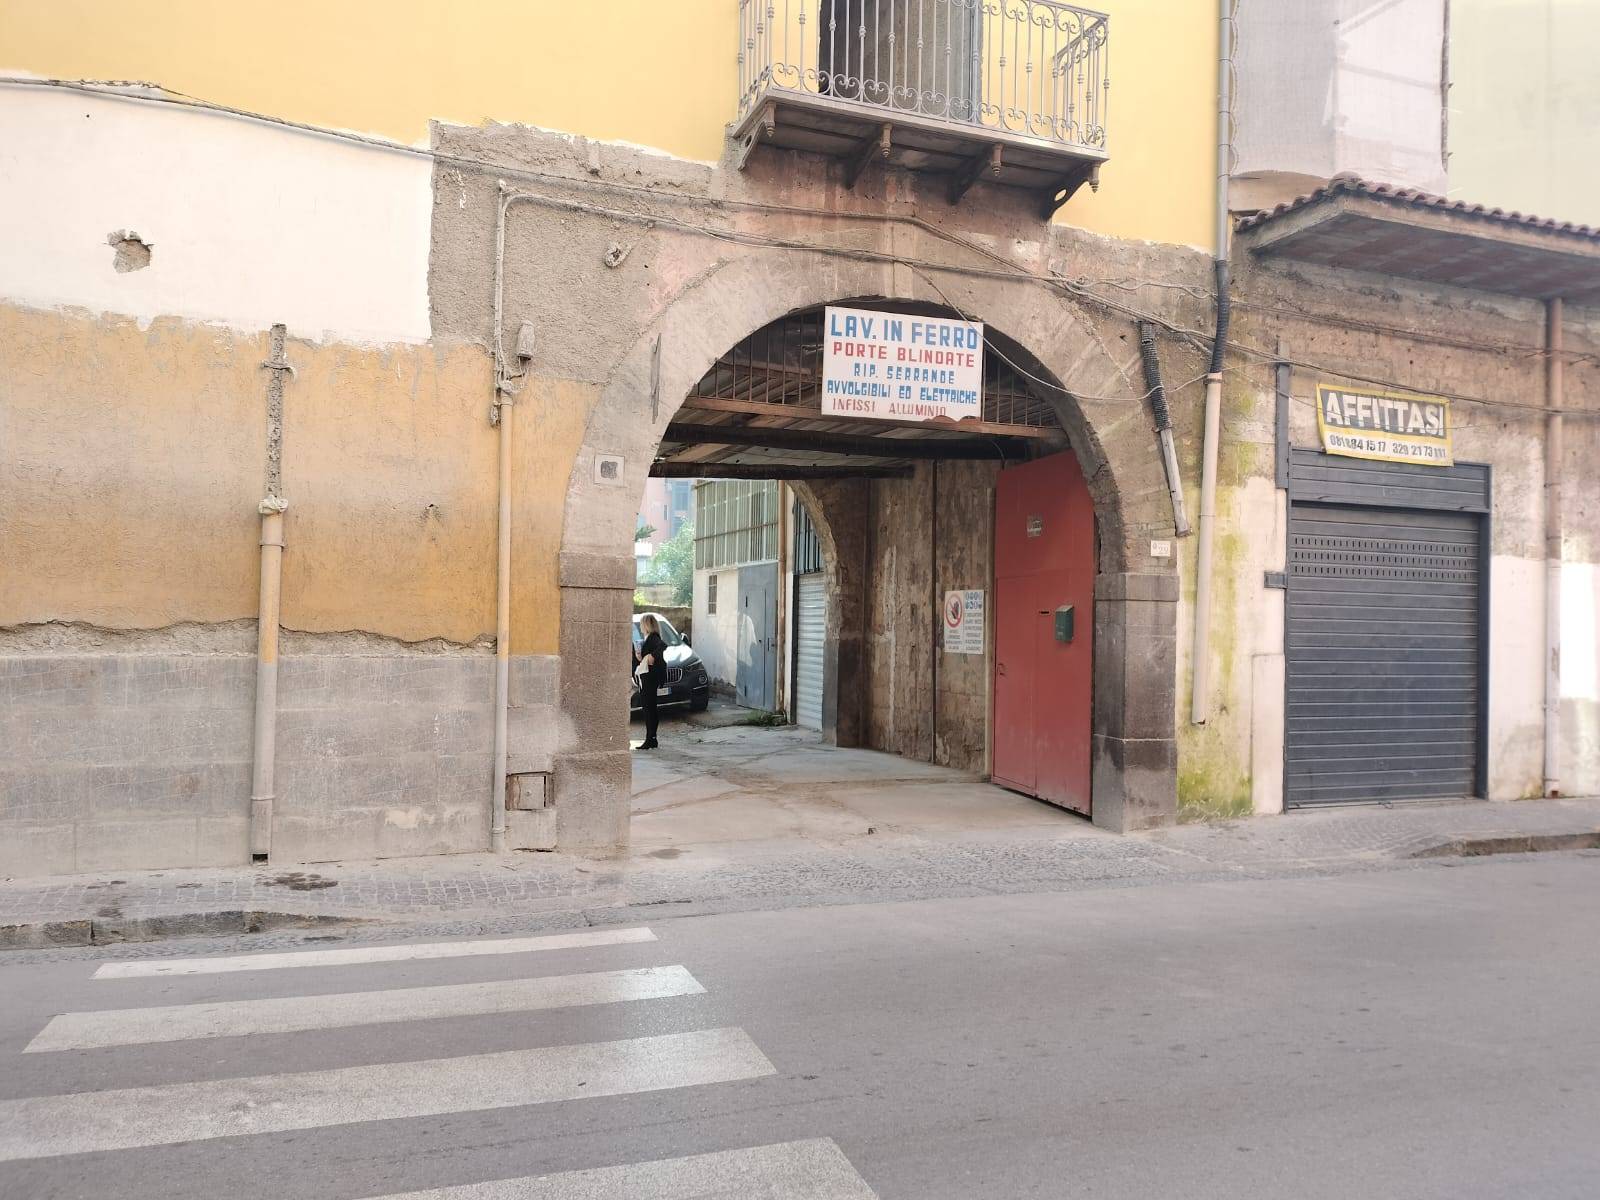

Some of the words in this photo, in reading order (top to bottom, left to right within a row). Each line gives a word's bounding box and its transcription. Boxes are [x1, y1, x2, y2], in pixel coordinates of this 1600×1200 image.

[831, 314, 876, 339] LAV.
[884, 320, 902, 341] IN
[912, 322, 977, 349] FERRO
[834, 342, 887, 359] PORTE
[898, 348, 974, 367] BLINDATE
[854, 363, 878, 378] RIP.
[887, 366, 954, 384] SERRANDE
[828, 380, 891, 397] AVVOLGIBILI
[899, 385, 911, 399] ED
[920, 387, 976, 404] ELETTRICHE
[833, 399, 875, 412] INFISSI
[889, 403, 946, 416] ALLUMINIO
[1326, 393, 1444, 436] AFFITTASI
